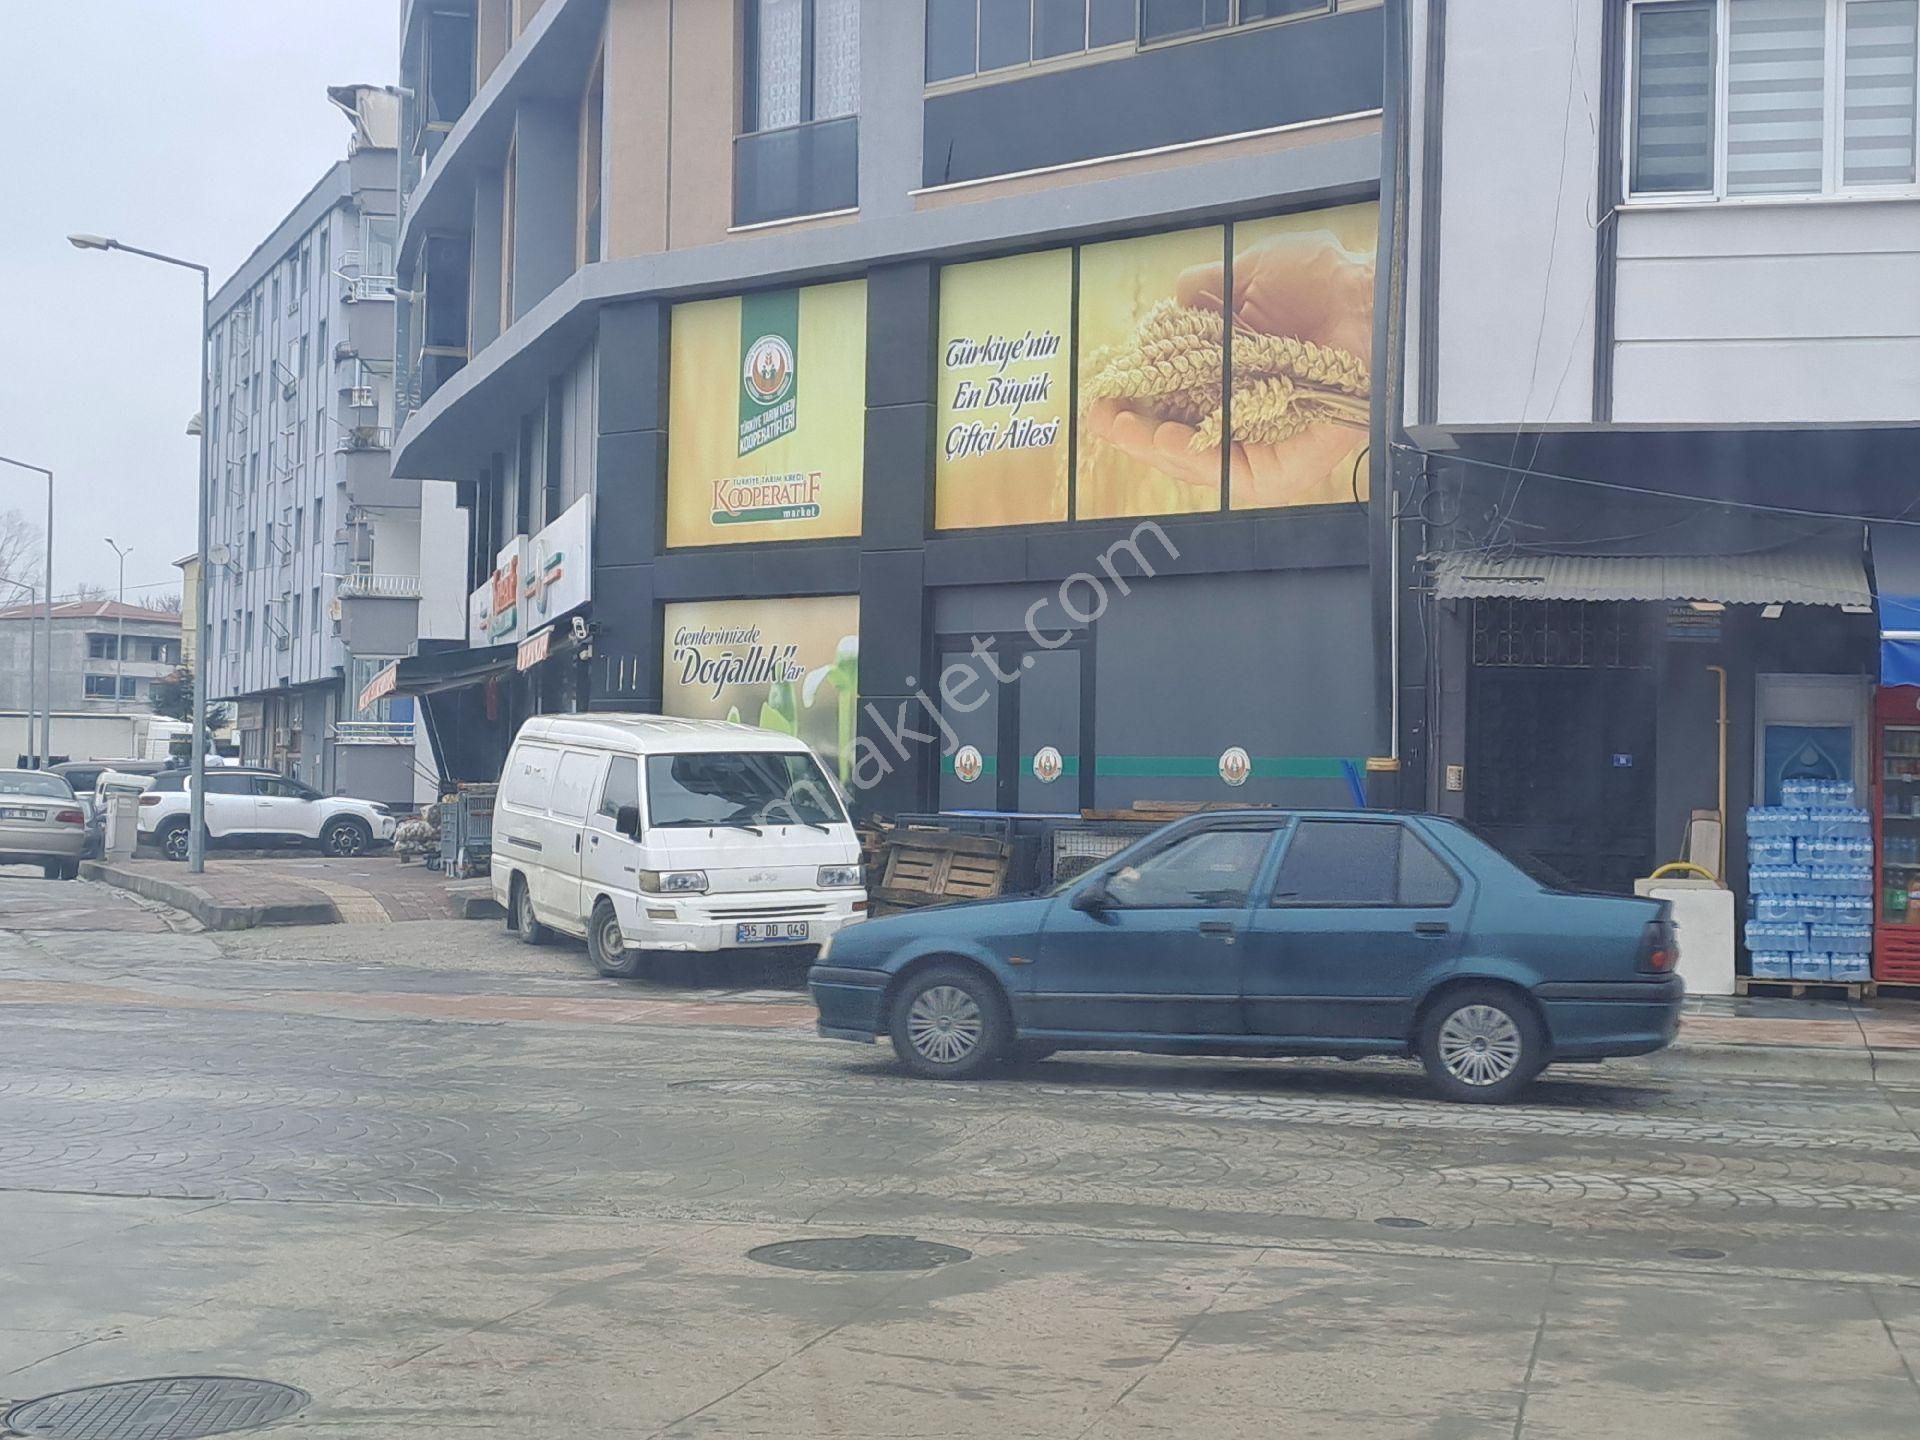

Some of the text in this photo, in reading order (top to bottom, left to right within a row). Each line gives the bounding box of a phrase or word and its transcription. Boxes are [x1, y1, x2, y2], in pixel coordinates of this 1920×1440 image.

[945, 330, 1061, 373] Türkiye'nin
[952, 372, 1053, 417] En Büyük
[945, 418, 1061, 462] Çiftçi Ailesi
[762, 475, 782, 483] TARIM
[782, 506, 816, 518] market
[673, 623, 760, 646] Genlerimizde
[781, 660, 805, 681] Var
